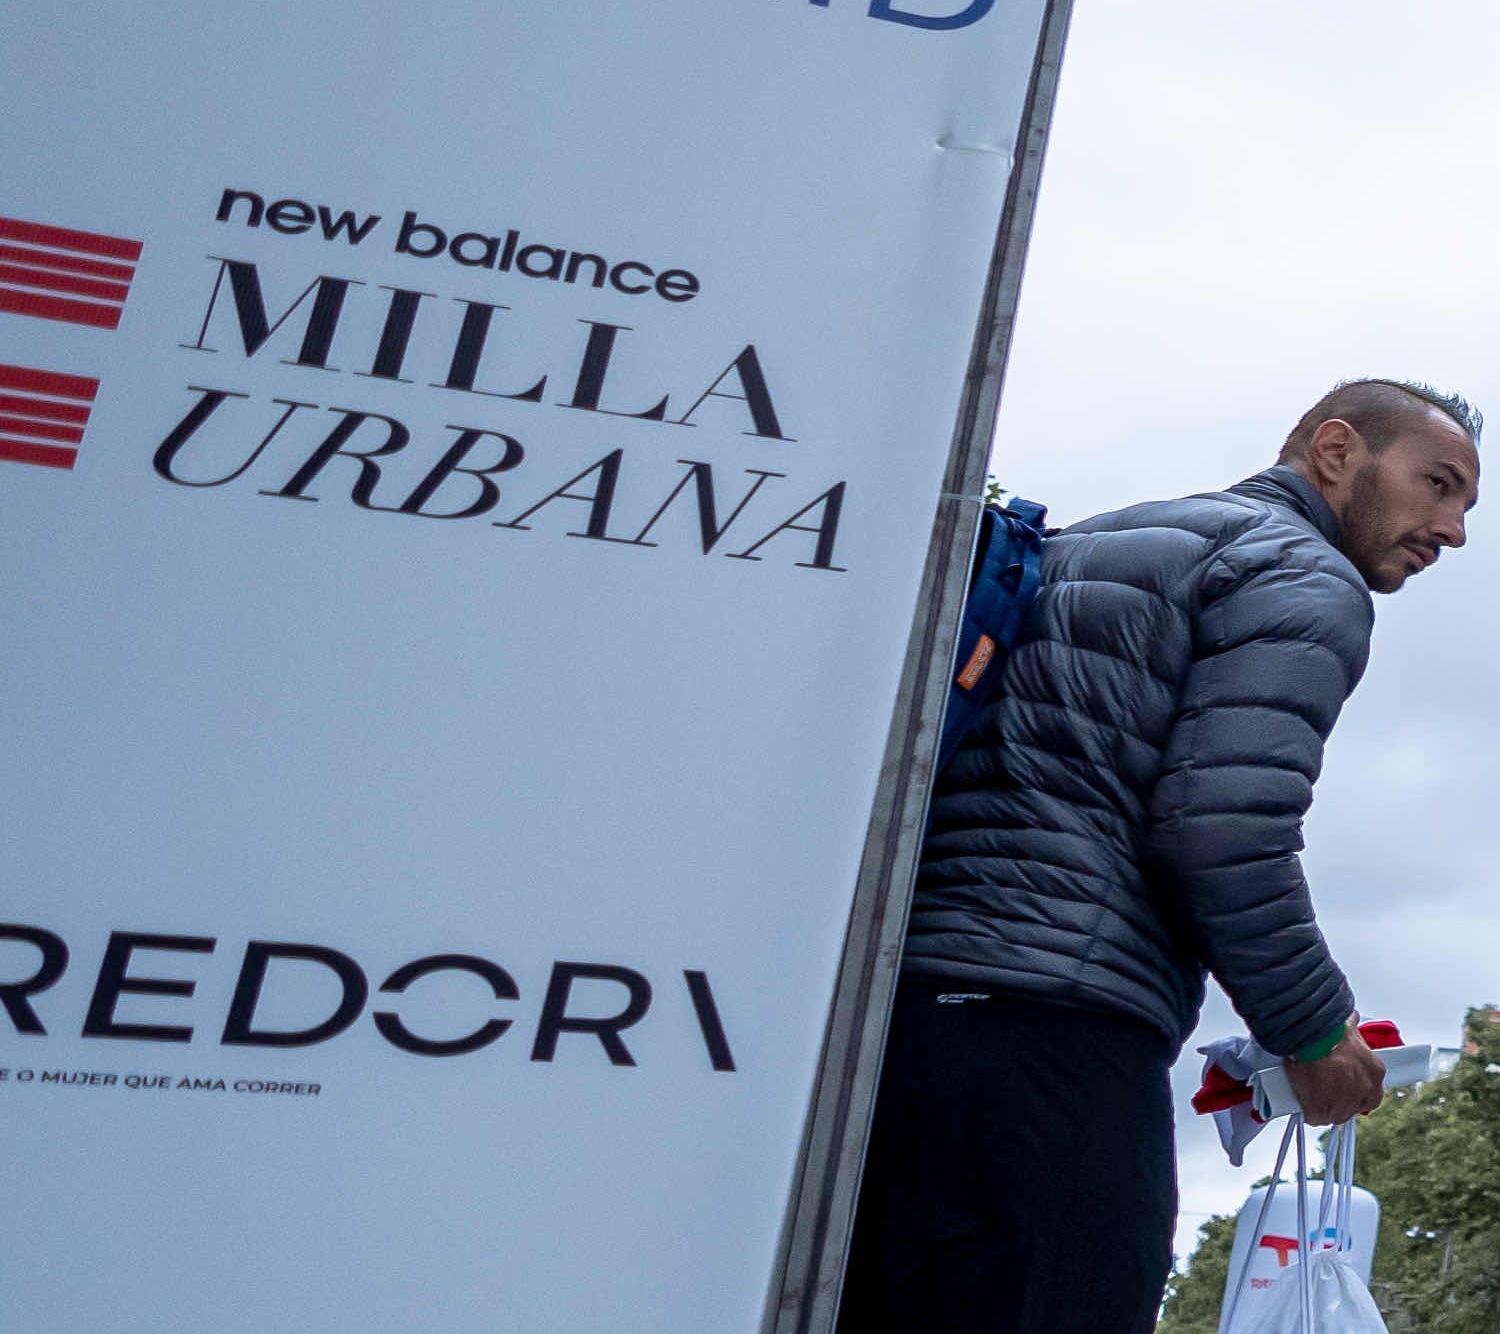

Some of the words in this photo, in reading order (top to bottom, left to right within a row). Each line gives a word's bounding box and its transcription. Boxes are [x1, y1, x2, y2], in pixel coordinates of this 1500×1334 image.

[215, 187, 381, 247] new
[393, 211, 701, 304] balance
[178, 256, 799, 443] MILLA
[151, 386, 848, 571] URBANA
[41, 1070, 118, 1086] MUJER
[125, 1075, 171, 1089] QUE
[177, 1078, 227, 1091] AMA
[233, 1079, 322, 1096] CORRER
